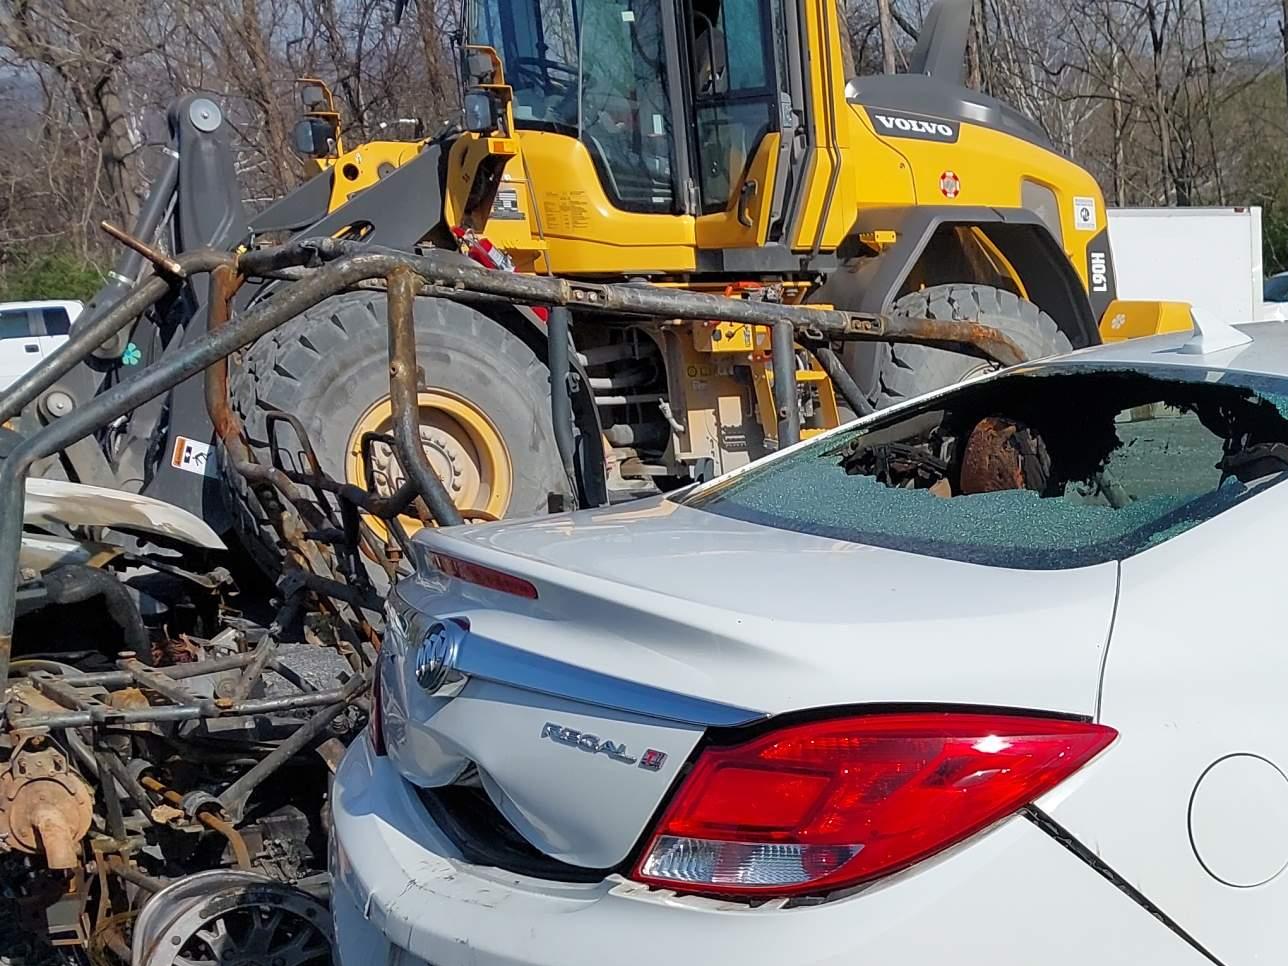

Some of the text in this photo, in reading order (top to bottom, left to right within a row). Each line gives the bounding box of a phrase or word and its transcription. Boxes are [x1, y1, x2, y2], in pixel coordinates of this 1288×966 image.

[874, 114, 953, 136] VOLVO
[1090, 252, 1108, 293] L90H
[540, 721, 638, 765] REGAL
